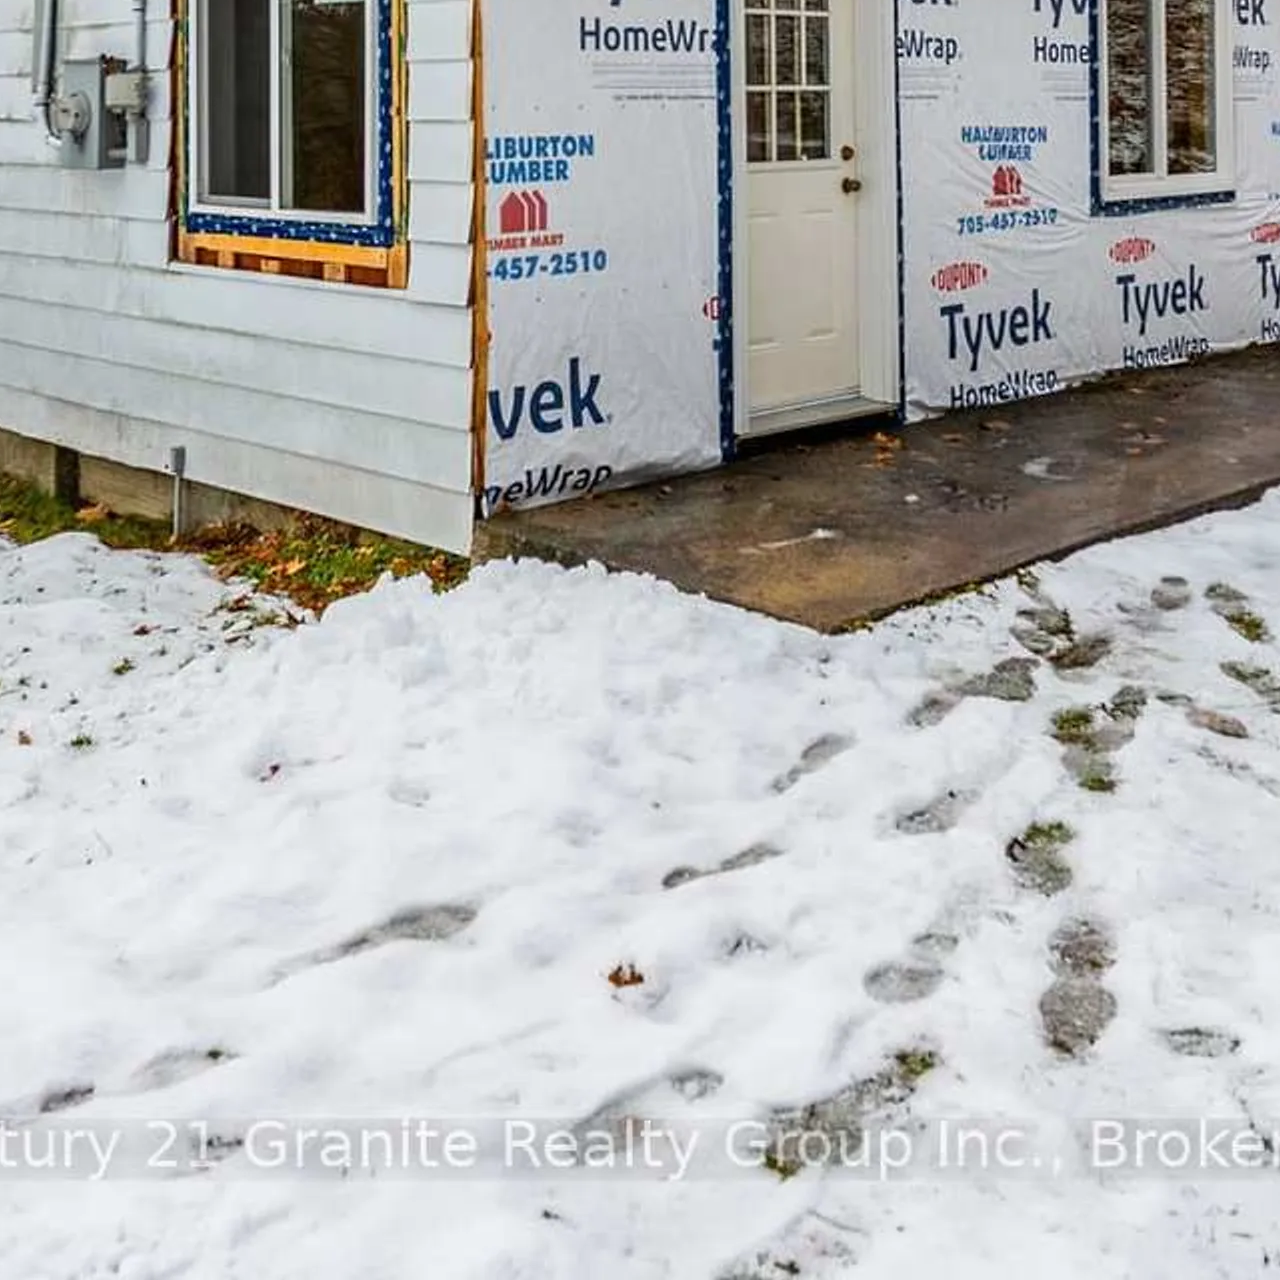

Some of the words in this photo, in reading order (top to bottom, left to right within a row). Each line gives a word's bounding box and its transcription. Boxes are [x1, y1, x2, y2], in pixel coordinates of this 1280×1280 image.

[579, 16, 718, 52] HomeWr
[485, 160, 570, 183] UMBER
[1116, 264, 1205, 336] Tyvek
[940, 288, 1053, 371] Tyvek
